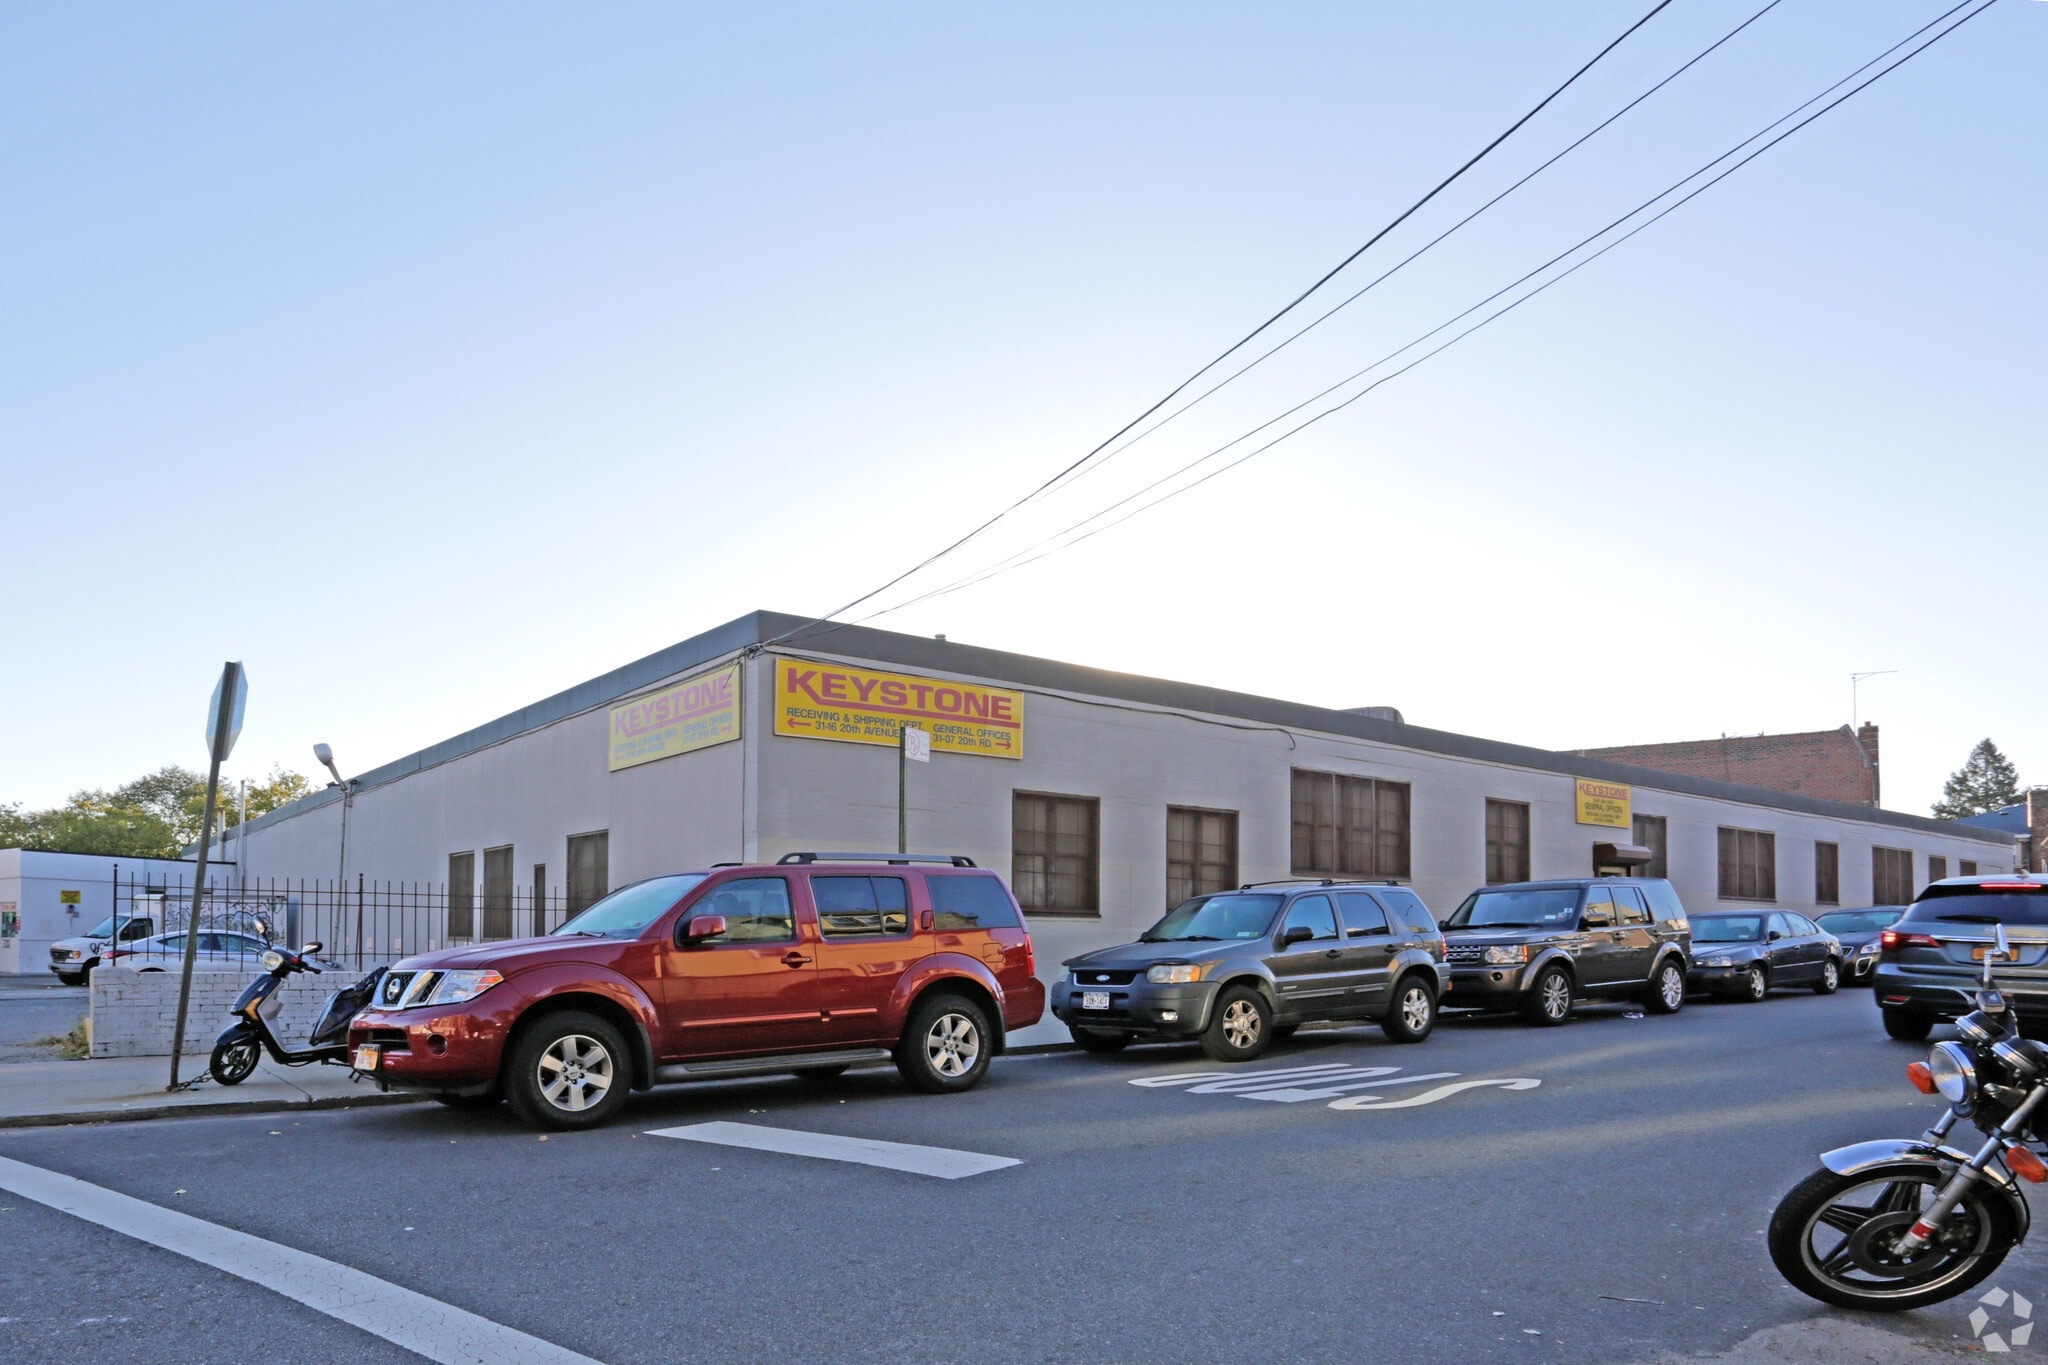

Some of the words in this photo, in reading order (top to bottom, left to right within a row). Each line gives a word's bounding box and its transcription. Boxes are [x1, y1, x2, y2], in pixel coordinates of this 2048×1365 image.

[787, 667, 1012, 721] KEYSTONE
[615, 673, 733, 736] KEYSTONE
[787, 707, 840, 721] RECEIVING
[843, 713, 850, 723] &
[853, 714, 896, 727] SHIPPING
[815, 721, 837, 731] 31-16
[840, 723, 860, 734] 20th
[864, 726, 900, 738] AVENUE
[933, 724, 974, 736] GENERAL
[976, 729, 1011, 740] OFFICES
[933, 734, 955, 744] 31-07
[957, 737, 976, 746] 20th
[979, 738, 992, 748] RD.
[1579, 782, 1628, 798] KEYSTONE
